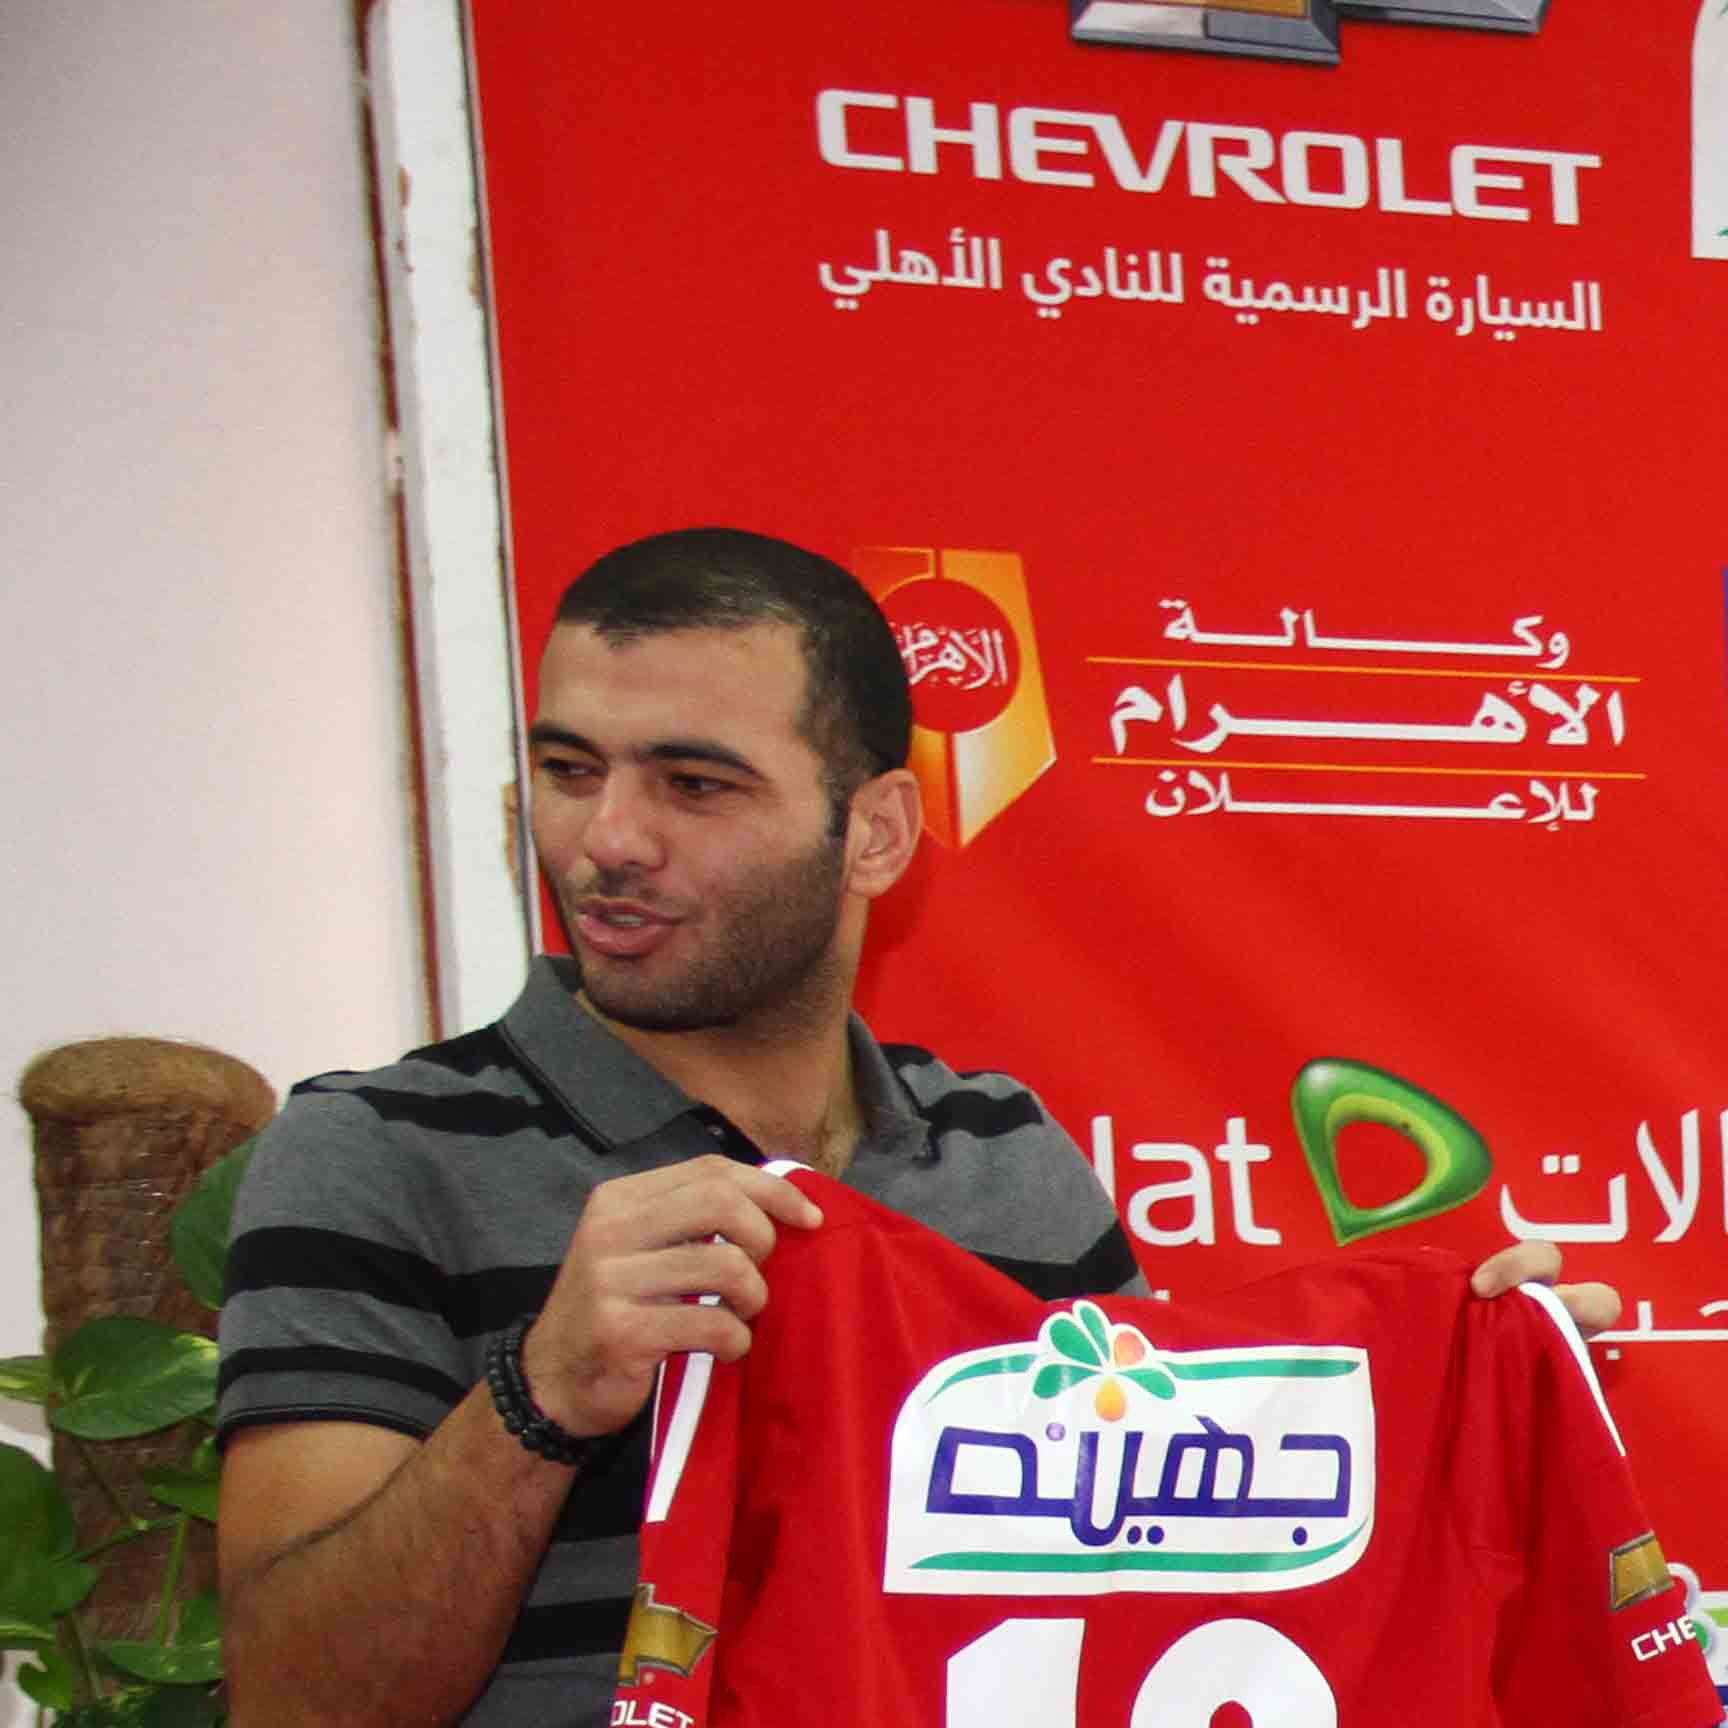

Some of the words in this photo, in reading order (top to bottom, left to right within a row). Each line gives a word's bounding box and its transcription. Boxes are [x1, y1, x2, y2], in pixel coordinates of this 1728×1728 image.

[817, 90, 1601, 225] CHEVROLET
[820, 228, 1002, 310] الأهلي
[1023, 248, 1184, 318] للنادي
[1204, 258, 1407, 328] الرسمية
[1427, 275, 1601, 341] السيارة
[1160, 600, 1569, 668] وكالة
